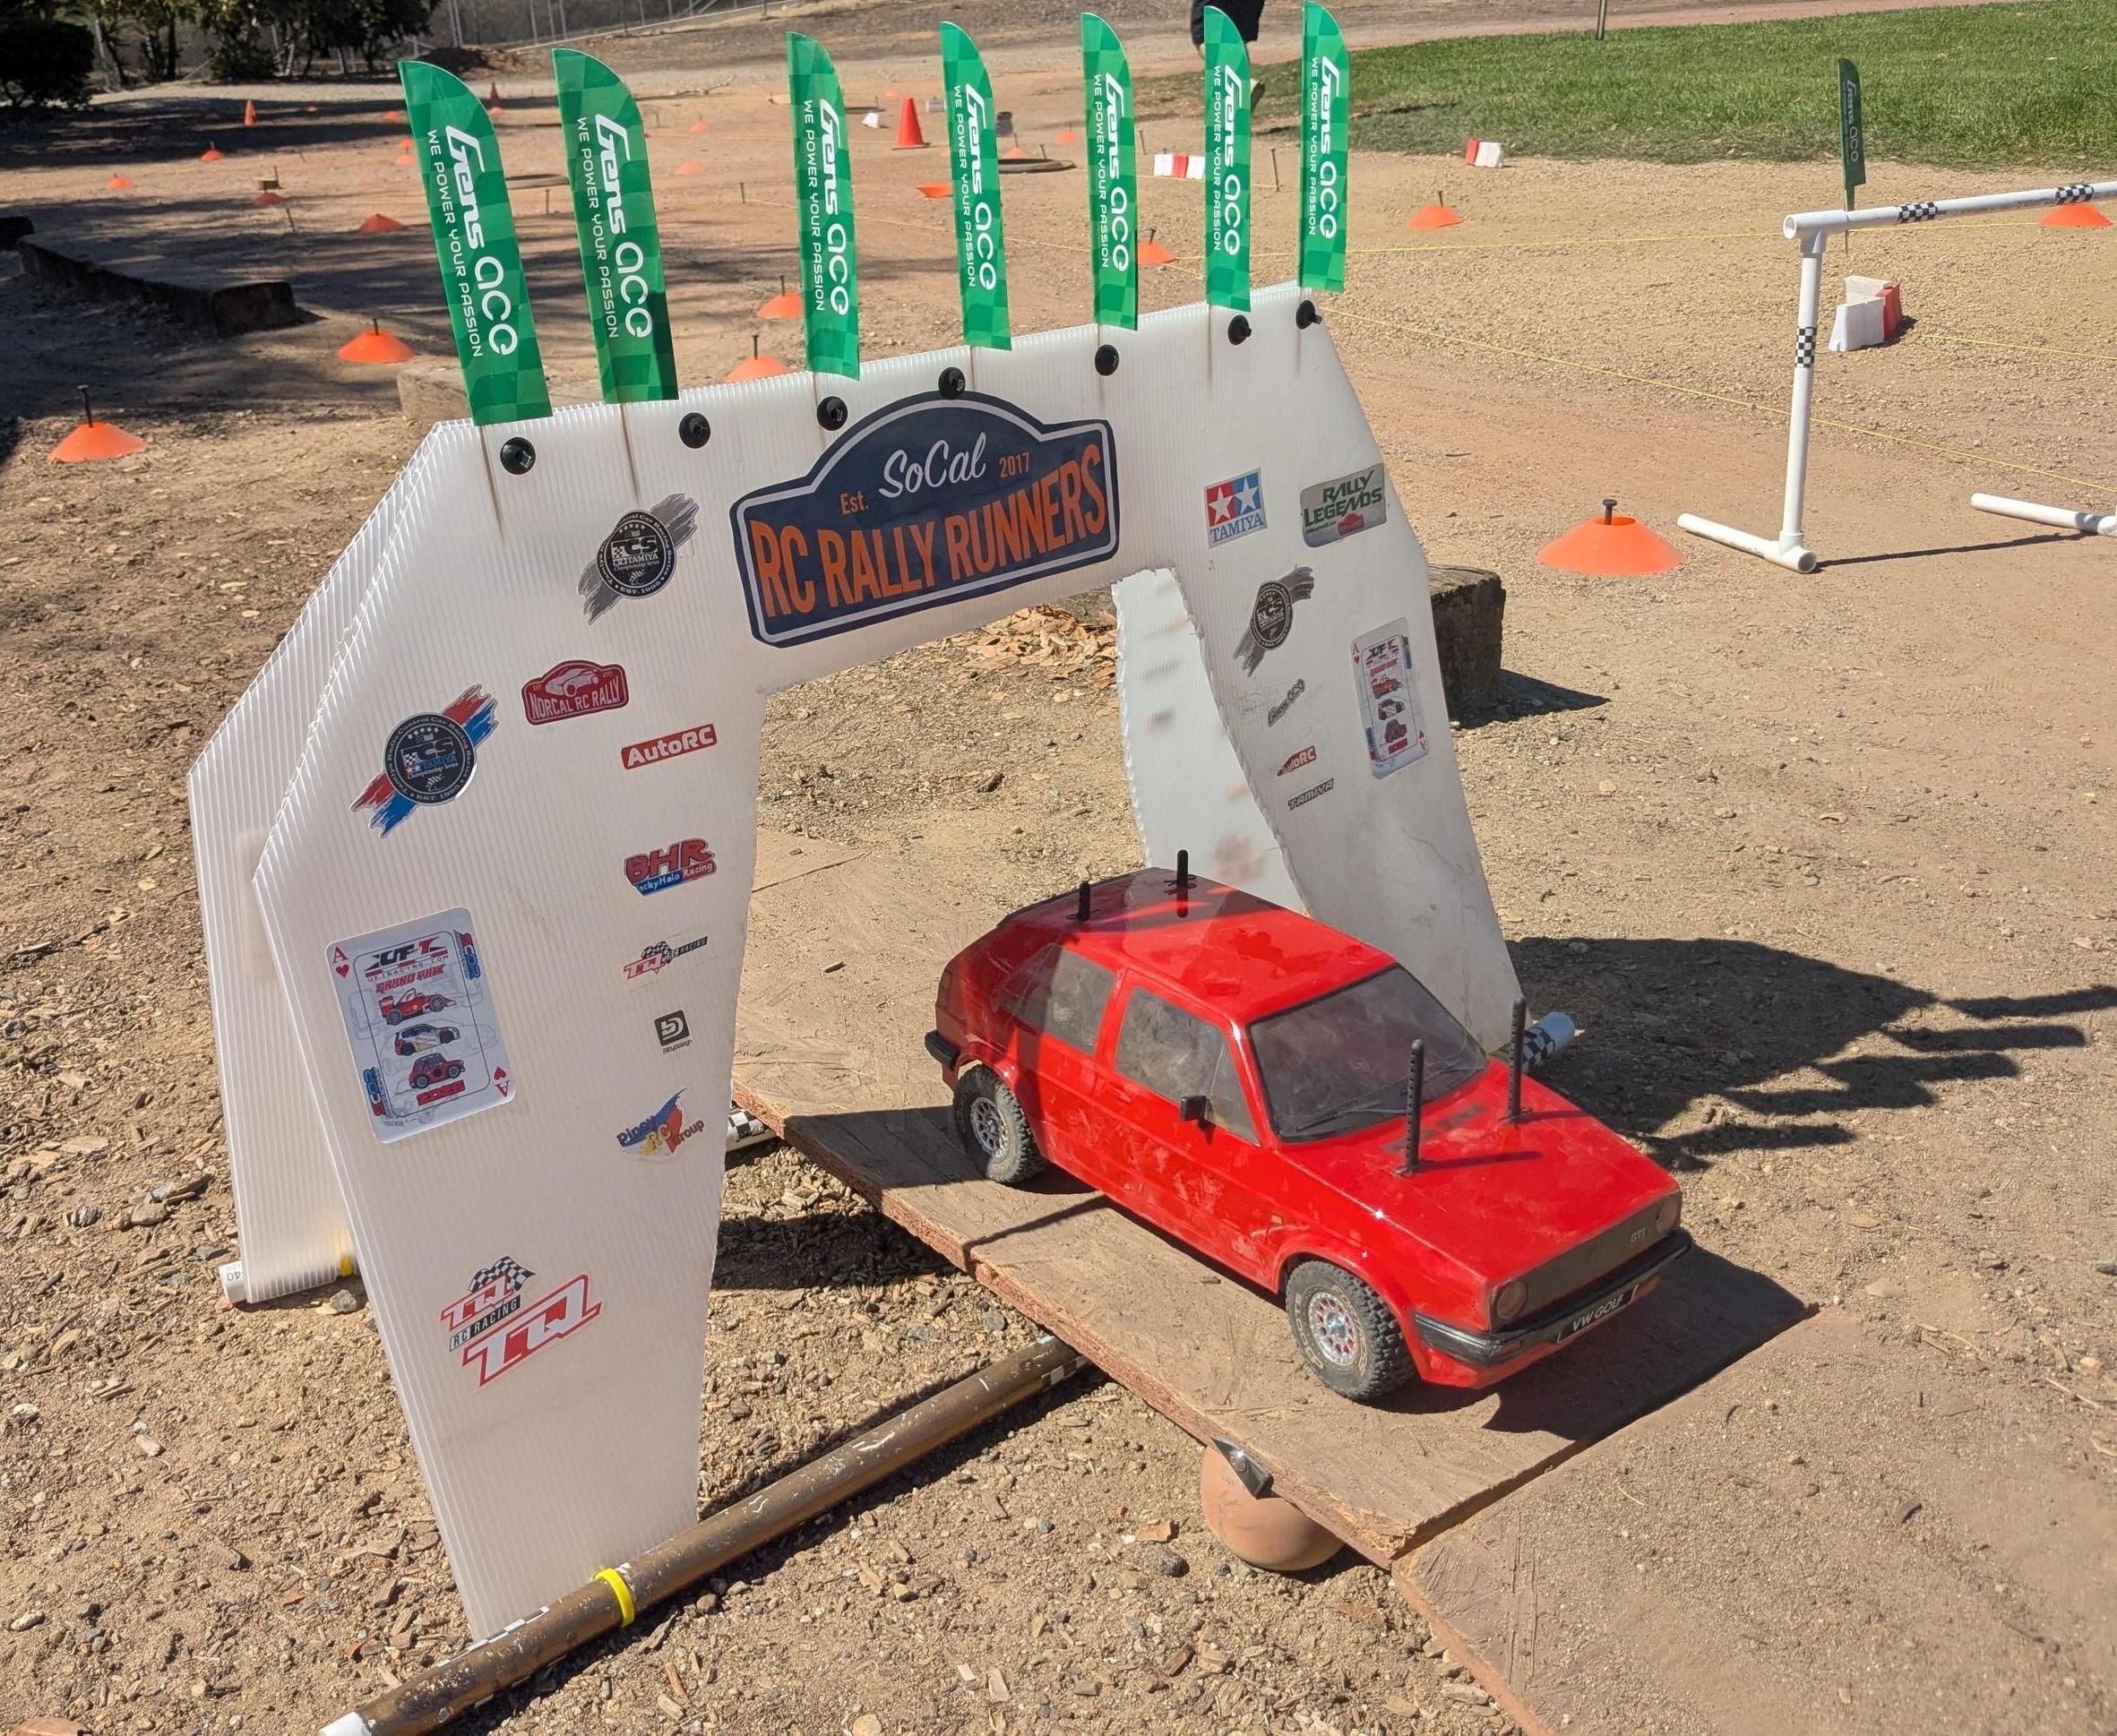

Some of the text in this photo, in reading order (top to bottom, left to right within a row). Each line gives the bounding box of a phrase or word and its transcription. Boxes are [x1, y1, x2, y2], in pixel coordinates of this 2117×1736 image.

[1312, 56, 1319, 78] WE
[1310, 82, 1319, 132] POWER
[1094, 74, 1109, 268] WE POWER YOUR PASSION
[1213, 65, 1221, 251] WE POWER YOUR PASSION
[1310, 135, 1318, 172] YOUR
[804, 100, 824, 311] WE POWER YOUR PASSION
[953, 85, 976, 288] WE POWER YOUR PASSION
[427, 129, 483, 357] WE POWER YOUR PASSION
[577, 116, 618, 339] WE POWER YOUR PASSION
[839, 451, 1030, 515] Est. 2017
[878, 432, 987, 499] SoCal
[1323, 469, 1374, 503] RALLY
[1210, 513, 1264, 543] TAMIYA
[1304, 487, 1382, 528] LEGENDS
[750, 444, 1107, 618] RC RALLY RUNNERS
[629, 553, 658, 563] TAMIYA
[529, 676, 621, 719] NORCAL RC RALLY
[627, 727, 714, 766] AutoRC
[1288, 778, 1333, 810] TAMIYA
[626, 839, 713, 885] BHR
[684, 863, 713, 878] Racing
[331, 946, 349, 964] A
[495, 1080, 510, 1097] A
[1631, 1227, 1646, 1242] GTI
[453, 1299, 518, 1347] RC RACING
[1572, 1293, 1624, 1332] VW GOLF
